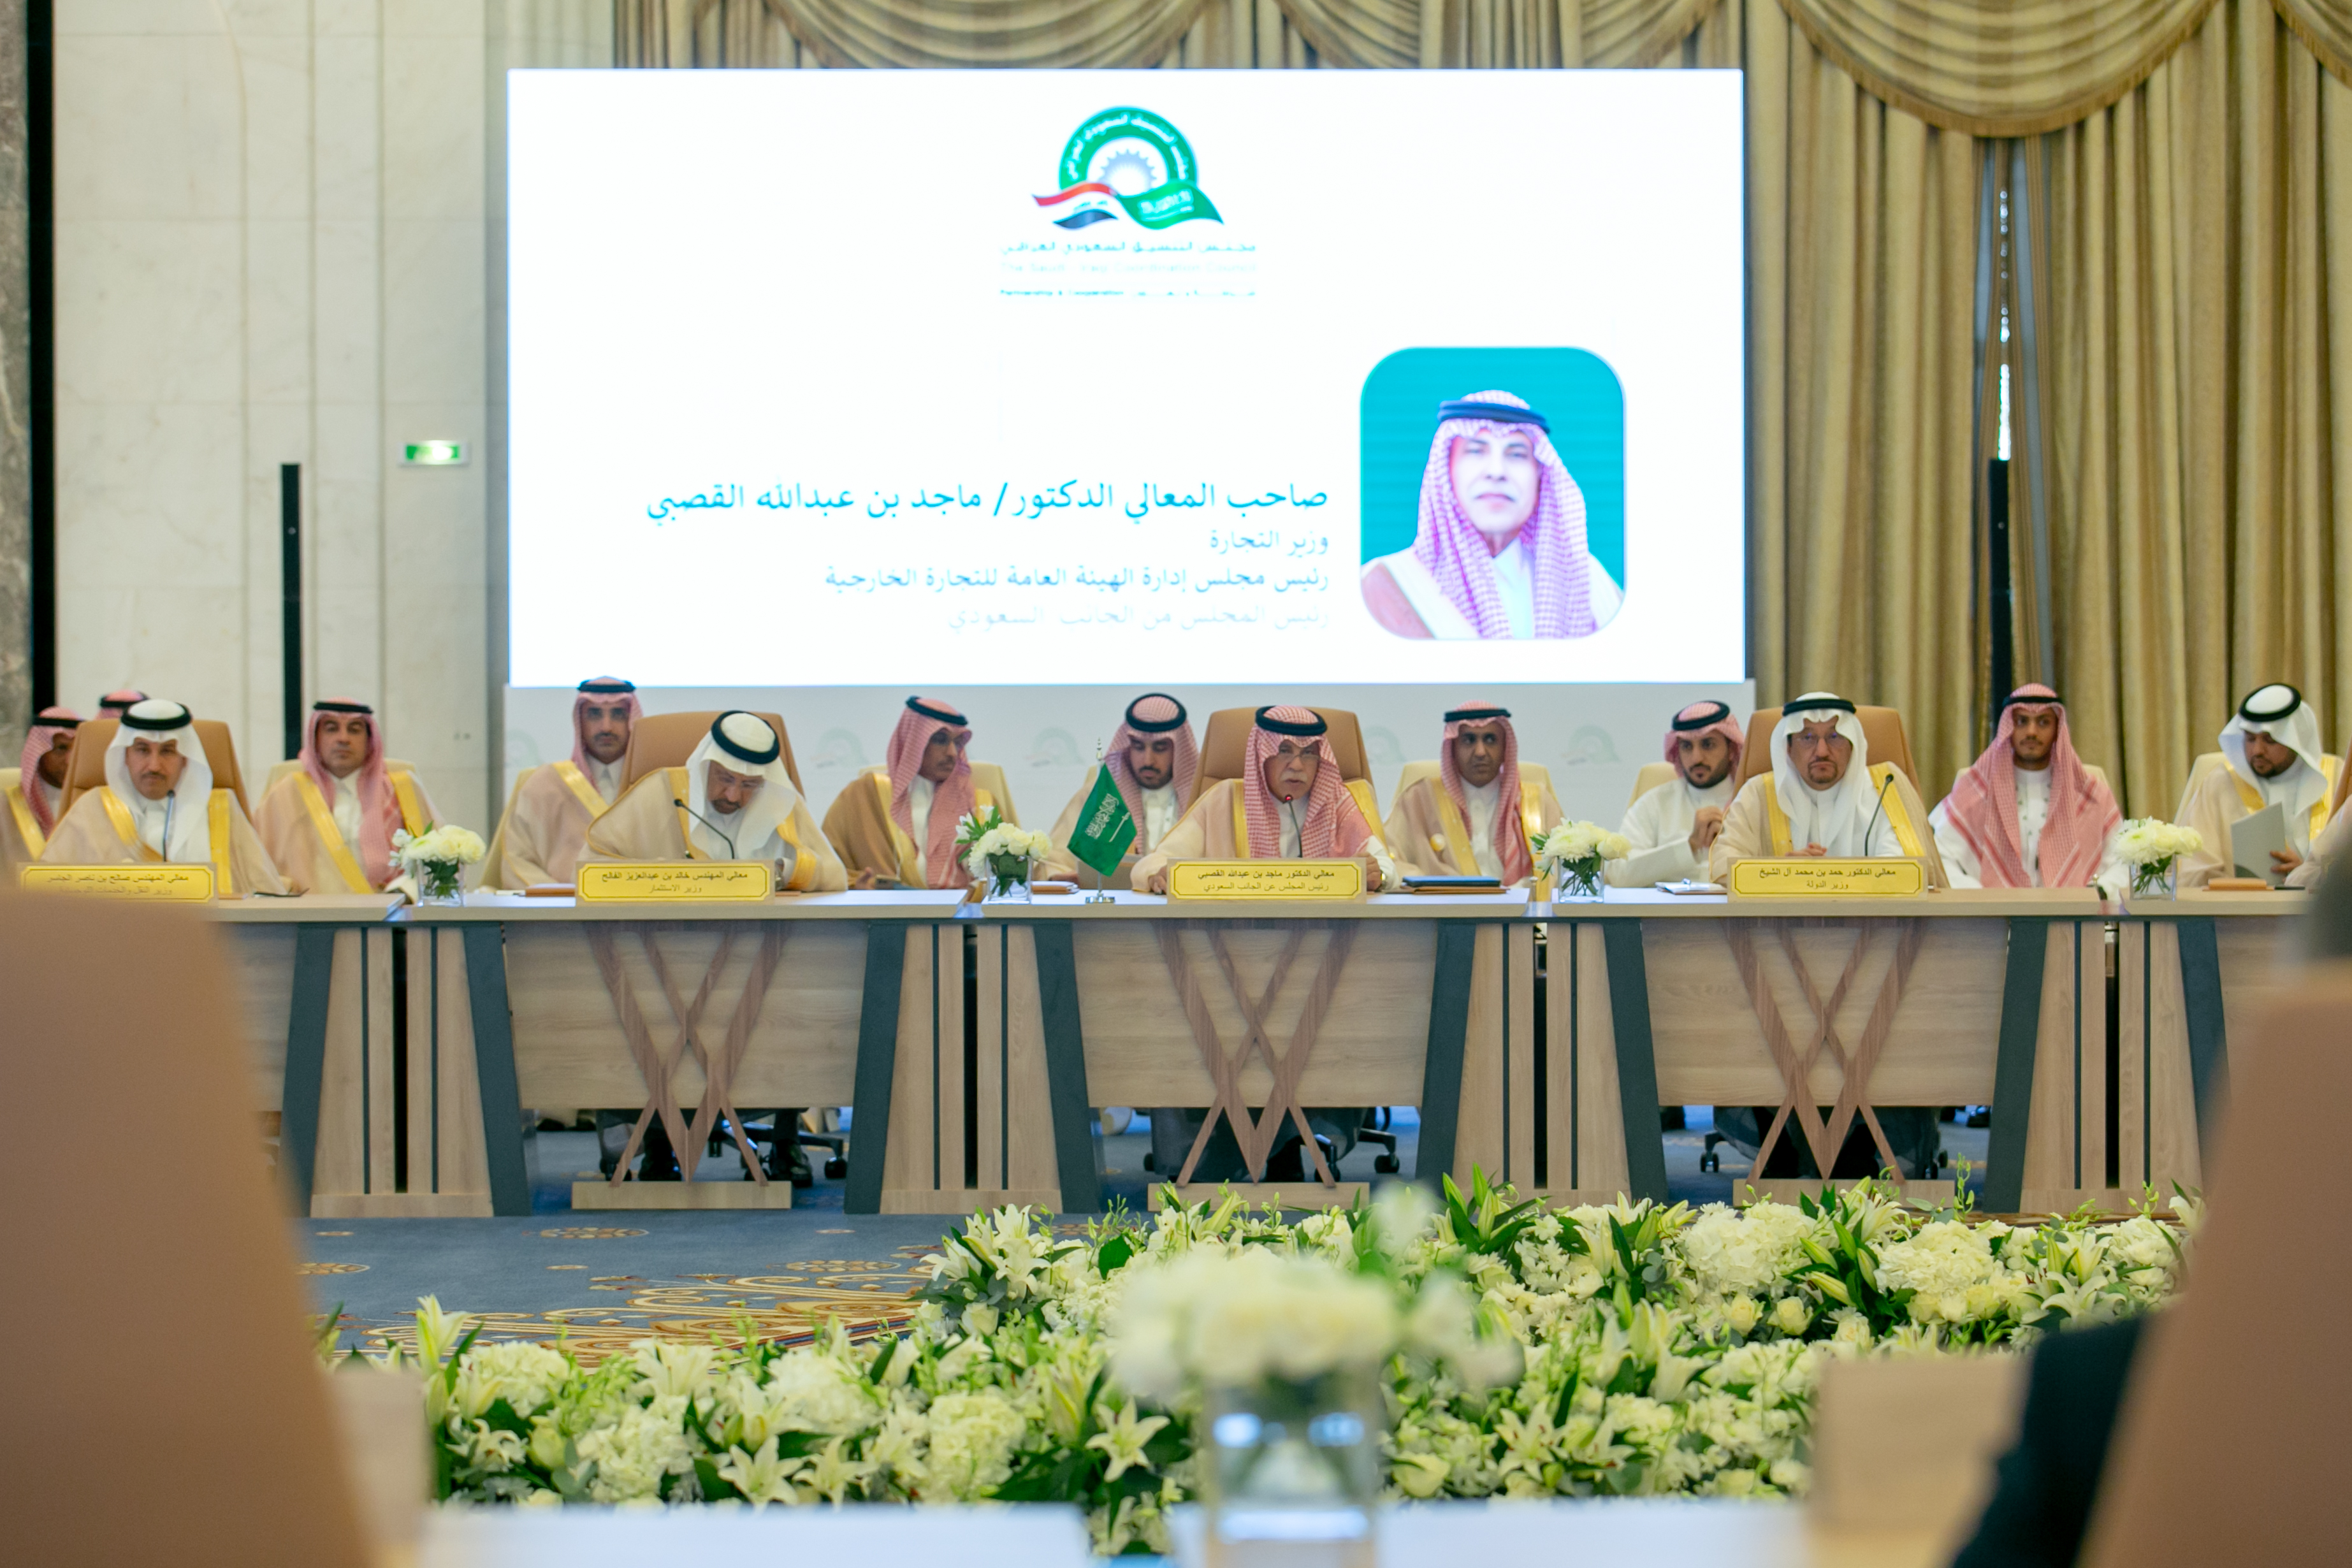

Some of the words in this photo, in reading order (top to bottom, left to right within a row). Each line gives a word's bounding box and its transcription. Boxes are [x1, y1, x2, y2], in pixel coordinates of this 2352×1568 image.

[646, 483, 744, 526] القصبي
[756, 482, 855, 518] عبدالله
[866, 491, 900, 519] بن
[910, 484, 982, 516] ماجد
[992, 479, 1113, 520] الدكتور/
[1124, 482, 1215, 525] المعالي
[1226, 483, 1328, 518] صاحب
[1209, 529, 1280, 555] التجارة
[1286, 530, 1329, 559] وزير
[824, 565, 917, 595] الخارجية
[925, 567, 998, 593] للتجارة
[1006, 565, 1067, 586] العامة
[1142, 566, 1187, 593] إدارة
[1194, 567, 1266, 594] مجلس
[1274, 567, 1329, 594] رئيس
[602, 872, 621, 882] الفالح
[626, 872, 658, 881] عبدالعزيز
[692, 872, 724, 880] المهندس
[727, 871, 748, 882] معالي
[1198, 869, 1224, 879] القصبي
[1265, 869, 1282, 878] ماجد
[1286, 869, 1310, 879] الدكتور
[1314, 869, 1335, 880] معالي
[1759, 868, 1780, 878] الشيخ
[1783, 867, 1791, 877] آل
[1847, 868, 1871, 877] الدكتور
[1875, 867, 1896, 878] معالي
[1203, 882, 1234, 892] السعودي
[1279, 882, 1305, 891] المجلس
[1806, 881, 1826, 889] الدولة
